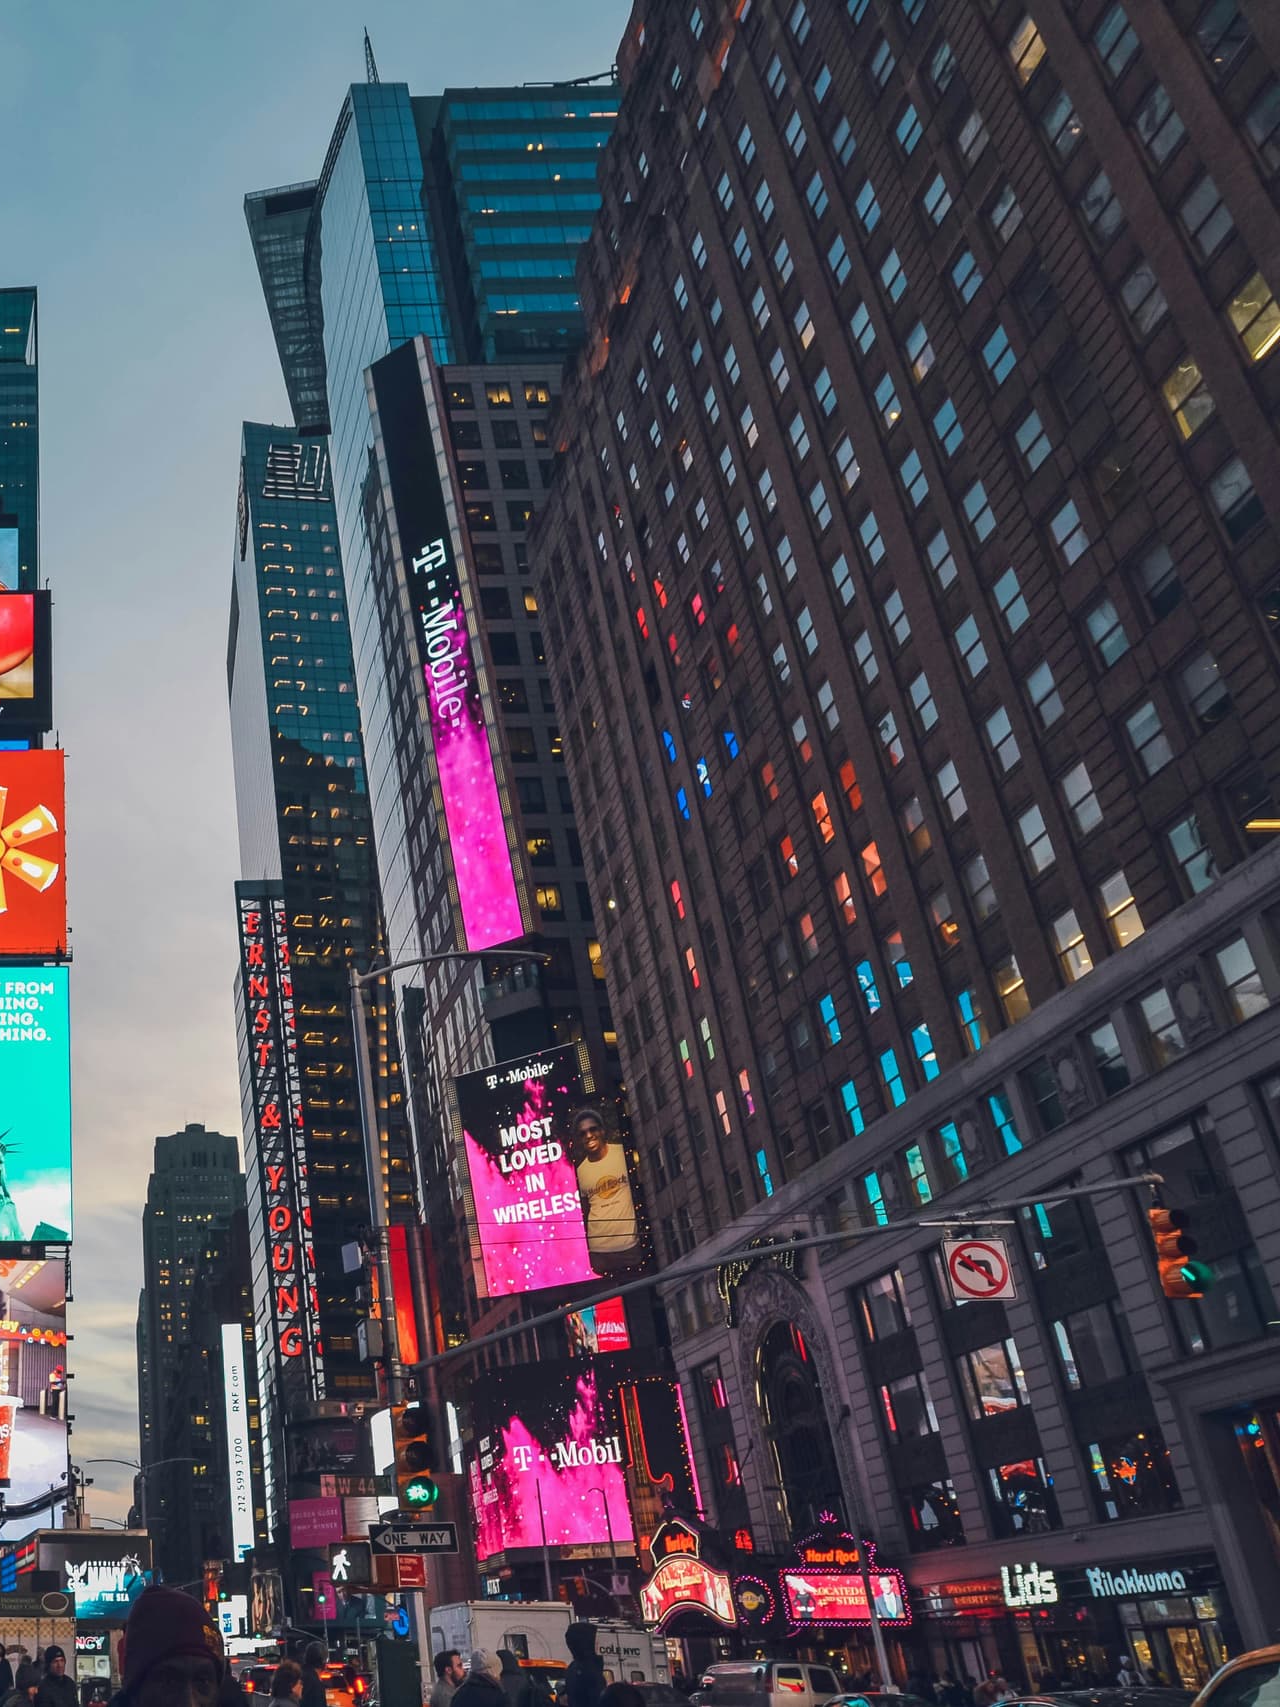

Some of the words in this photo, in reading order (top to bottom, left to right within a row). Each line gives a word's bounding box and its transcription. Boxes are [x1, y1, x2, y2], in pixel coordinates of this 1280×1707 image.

[5, 982, 55, 995] FROM
[246, 911, 273, 1068] ERNST
[260, 1103, 282, 1128] &
[500, 1117, 553, 1148] MOST
[499, 1142, 563, 1174] LOVED
[525, 1172, 546, 1193] IN
[492, 1190, 582, 1225] WIRELESS
[266, 1165, 304, 1358] YOUNG
[234, 1437, 244, 1467] 3700
[236, 1469, 246, 1491] 599
[338, 1477, 351, 1495] W
[357, 1477, 377, 1495] 44
[237, 1495, 247, 1513] 212
[383, 1533, 409, 1546] ONE
[418, 1532, 446, 1544] WAY
[806, 1549, 834, 1564] Hard
[1001, 1560, 1059, 1607] Lids
[1085, 1565, 1187, 1598] Rilakkuma
